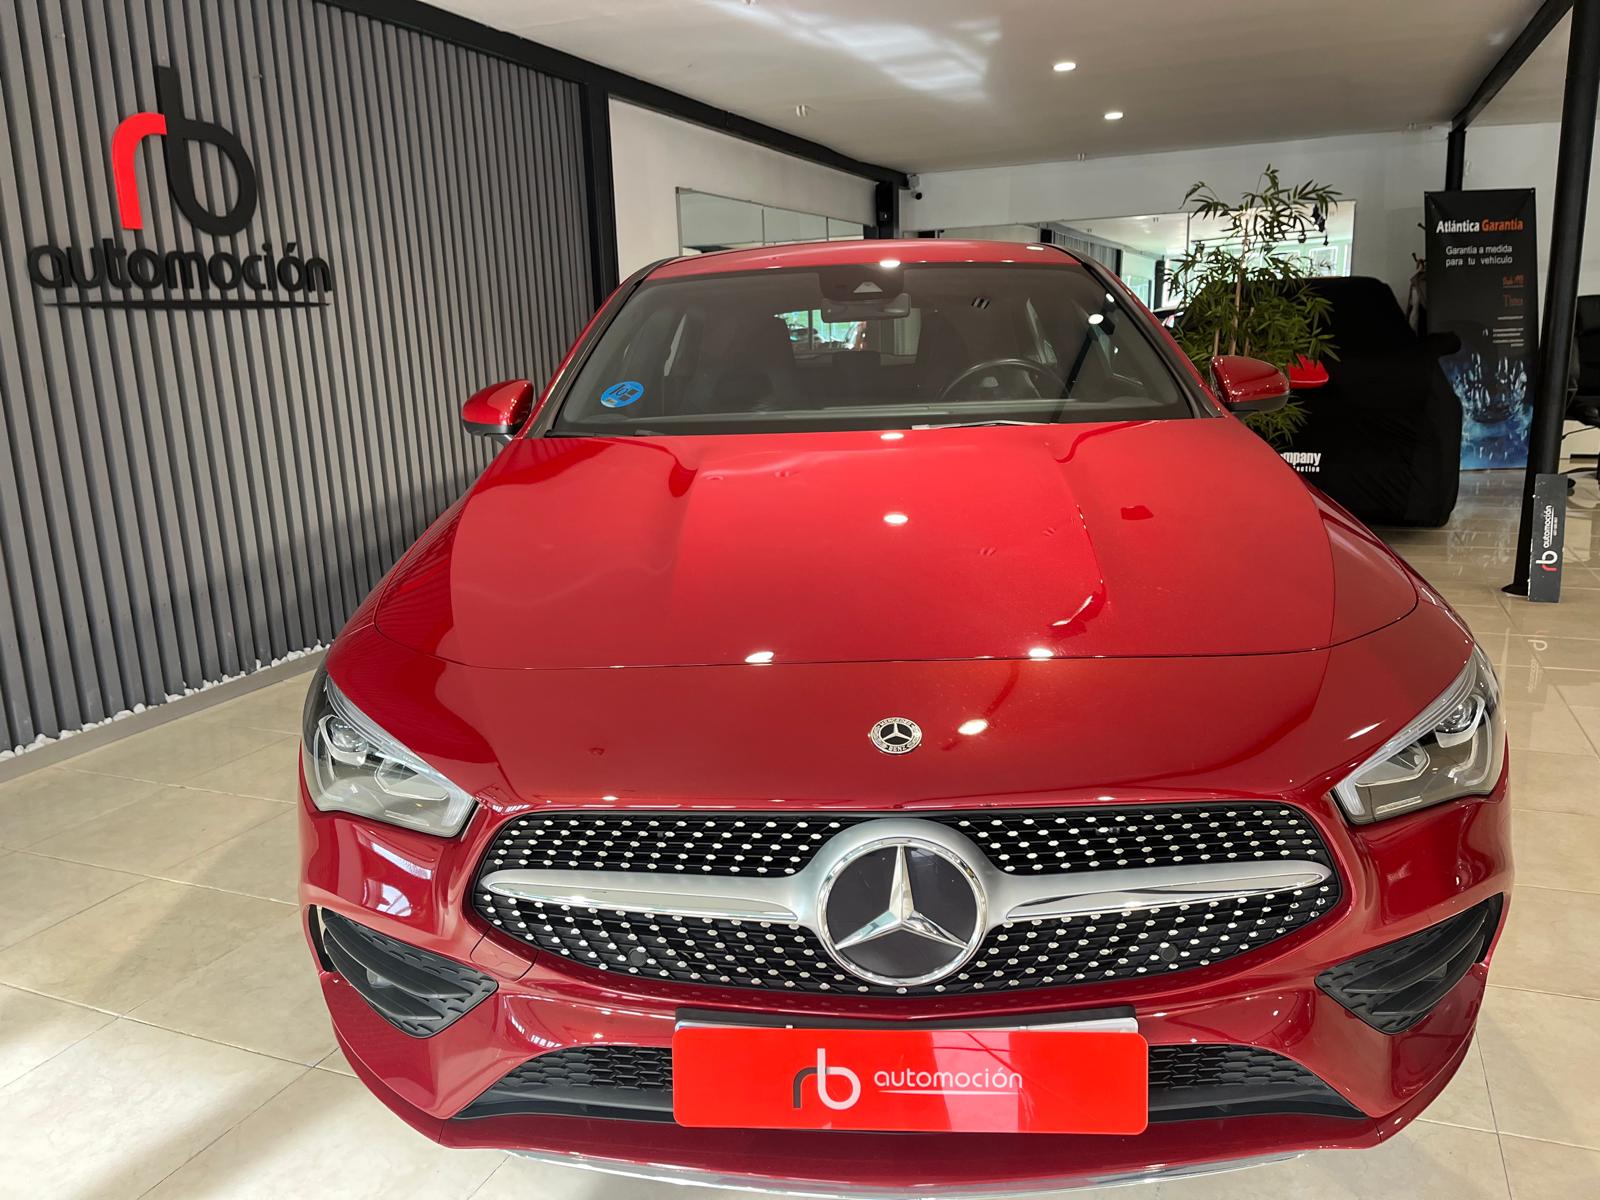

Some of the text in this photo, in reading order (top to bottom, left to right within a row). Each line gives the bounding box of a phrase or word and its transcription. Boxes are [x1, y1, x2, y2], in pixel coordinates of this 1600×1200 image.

[1436, 219, 1480, 233] Atlántica
[1485, 244, 1513, 254] medida
[27, 238, 332, 293] automoción
[1445, 258, 1463, 269] para
[1467, 257, 1476, 266] tu
[1280, 452, 1321, 466] mpany
[1542, 505, 1553, 549] automoción
[793, 1048, 1023, 1111] rb automoción
